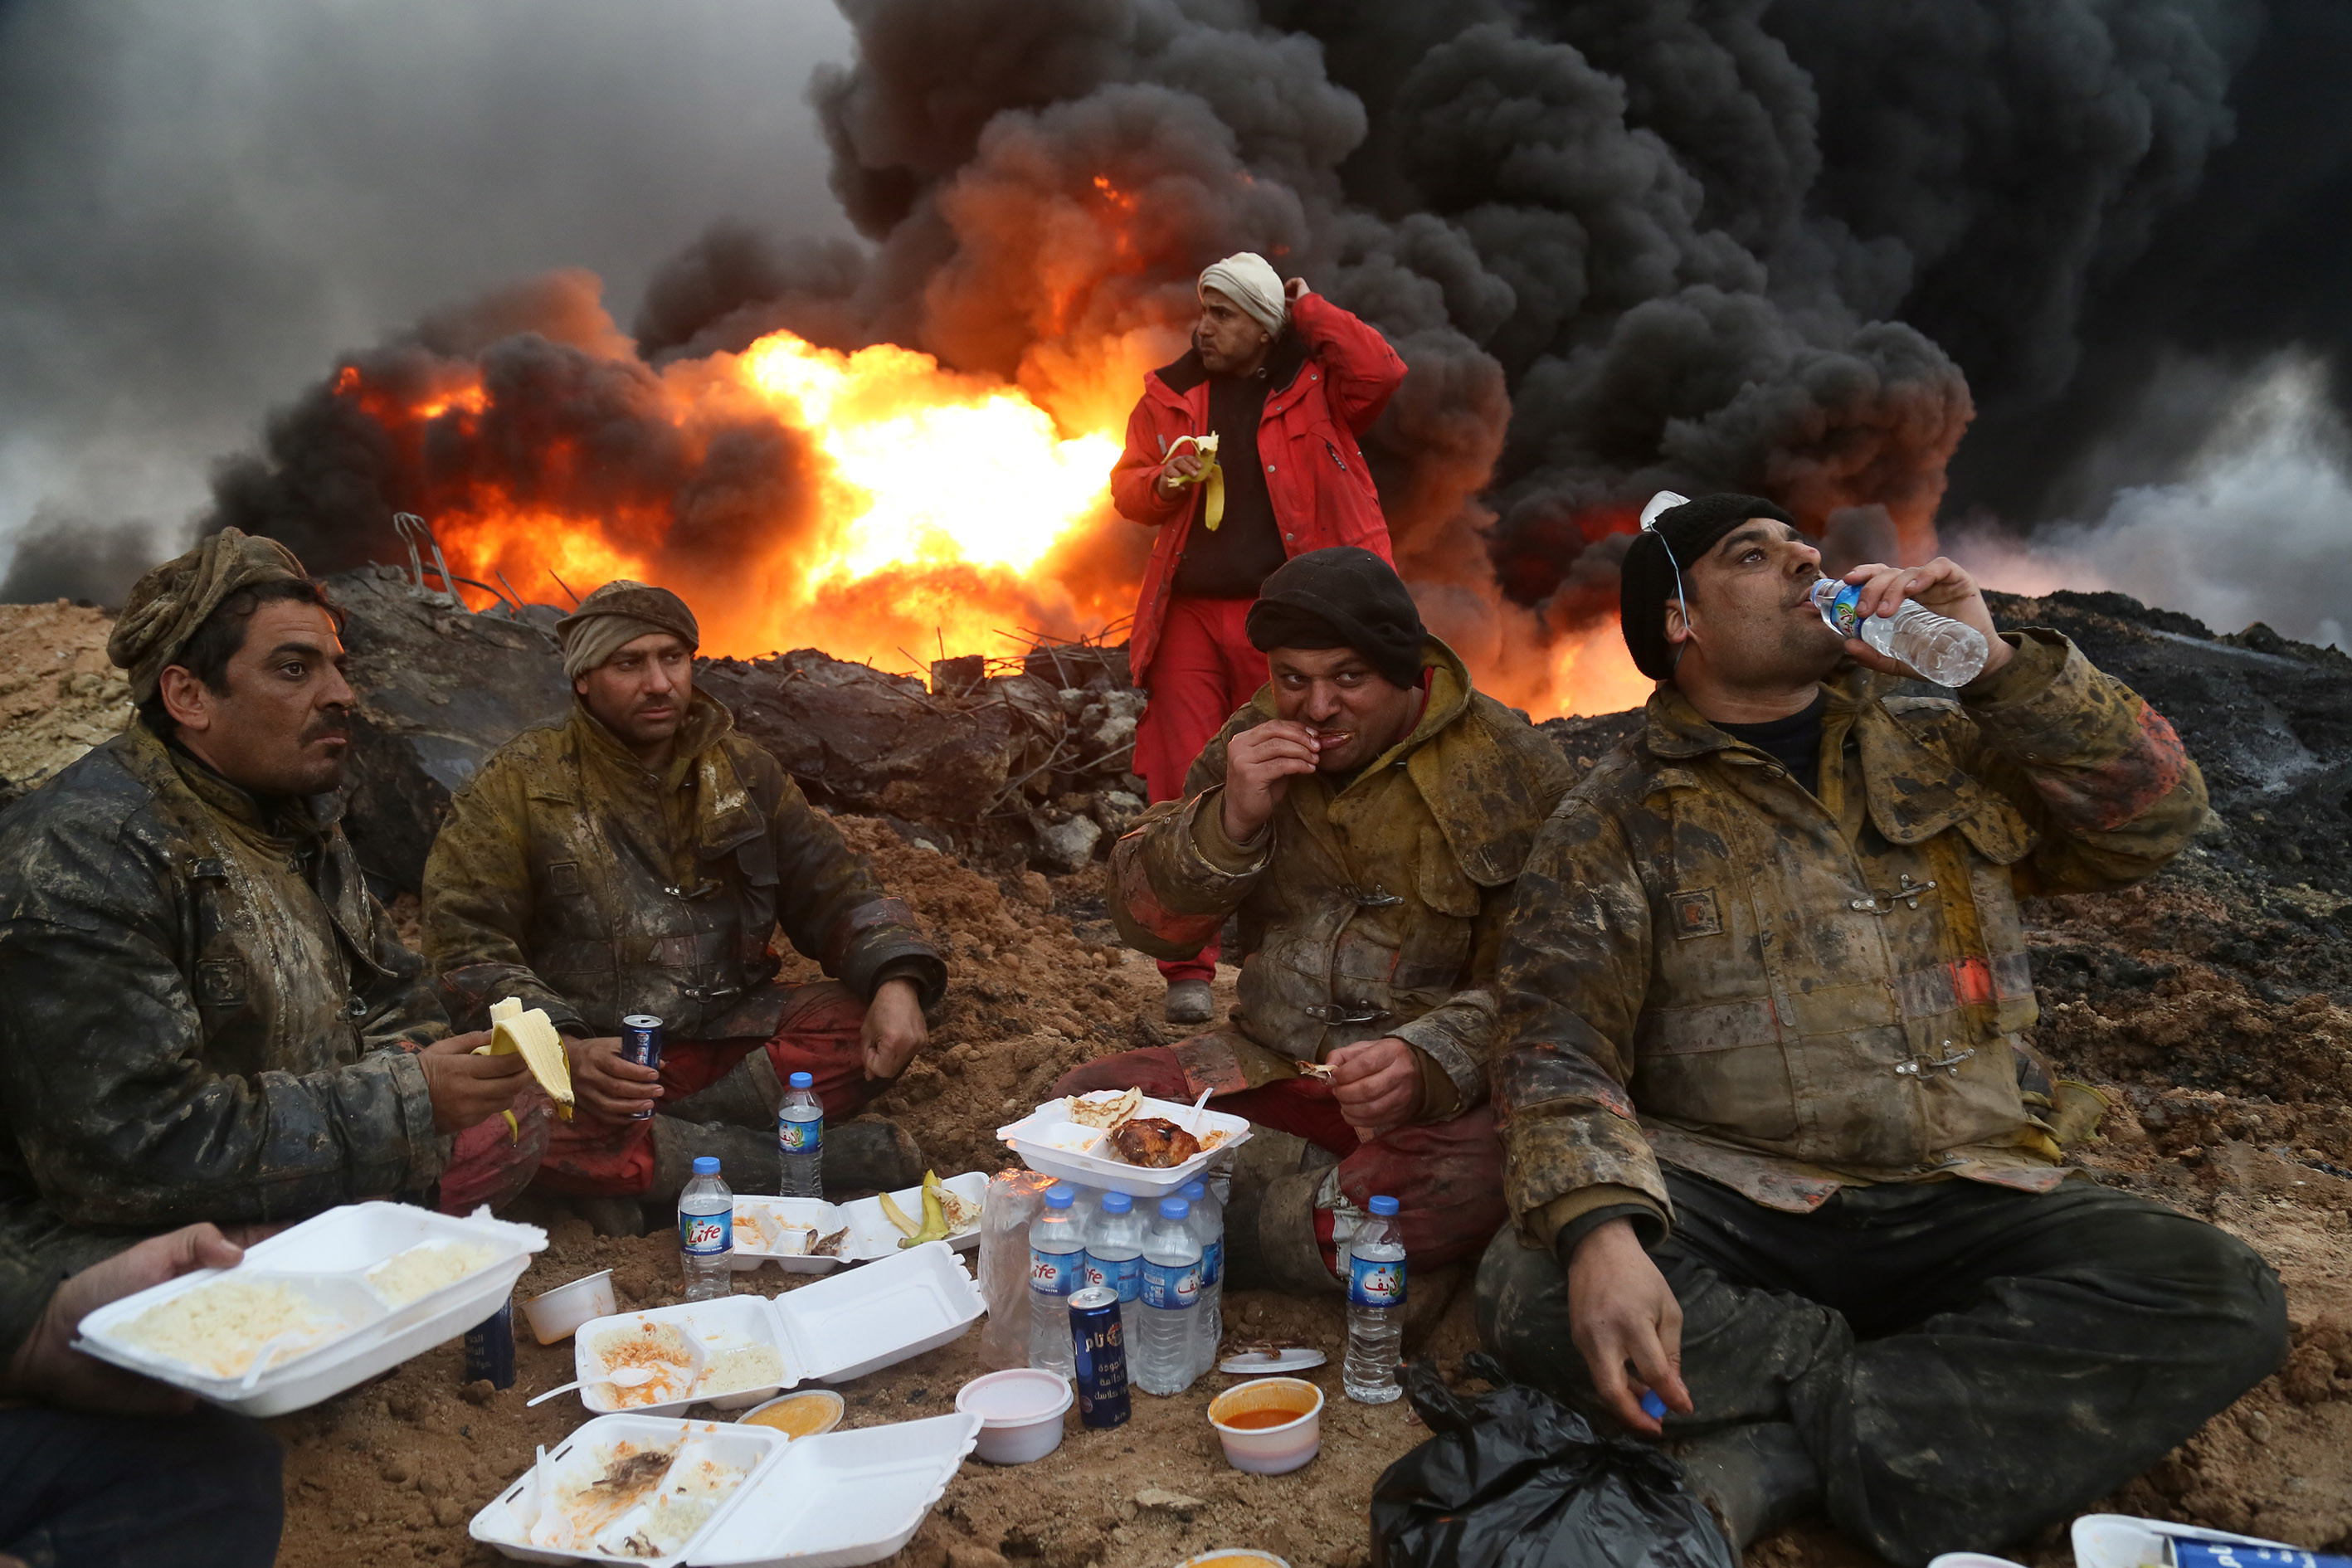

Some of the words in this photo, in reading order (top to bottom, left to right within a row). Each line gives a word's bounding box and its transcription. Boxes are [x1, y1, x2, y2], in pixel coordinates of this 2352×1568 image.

[688, 1225, 721, 1244] Life
[1033, 1264, 1056, 1279] ife
[1364, 1274, 1400, 1296] لايف
